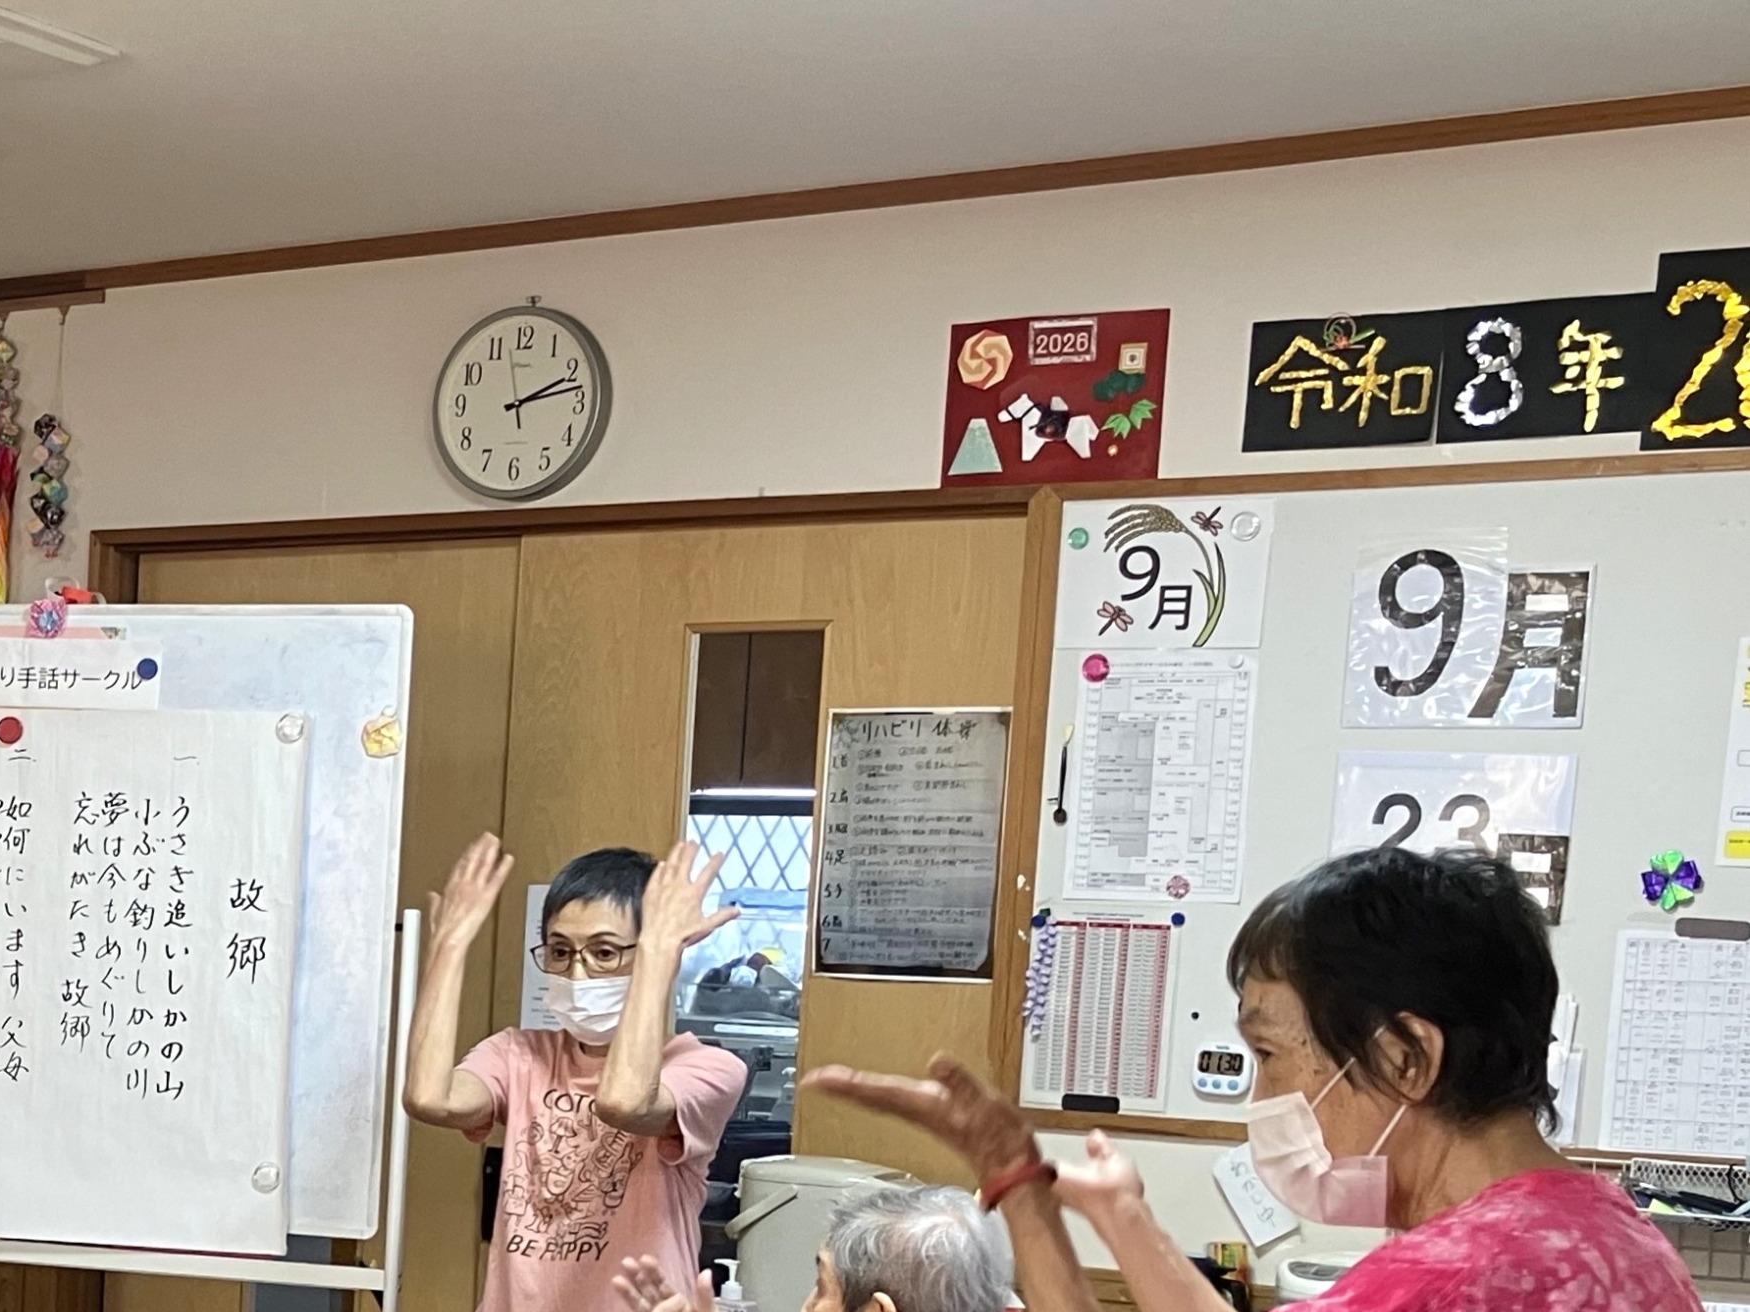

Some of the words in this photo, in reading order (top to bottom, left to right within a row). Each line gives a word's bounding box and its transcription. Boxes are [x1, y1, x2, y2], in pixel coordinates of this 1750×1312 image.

[488, 337, 503, 361] 11
[516, 325, 534, 351] 12
[550, 334, 558, 358] 1
[1036, 332, 1089, 355] 2026
[565, 358, 578, 383] 2
[1650, 278, 1750, 441] 2
[464, 361, 482, 386] 10
[455, 393, 467, 418] 9
[572, 389, 585, 415] 3
[460, 427, 472, 451] 8
[561, 422, 573, 447] 4
[481, 449, 493, 473] 7
[508, 457, 520, 481] 6
[538, 447, 551, 471] 5
[1118, 544, 1192, 632] 9月
[1373, 547, 1591, 719] 9月
[862, 718, 921, 743] リハビリ
[95, 792, 129, 1060] 夢は今もめぐりて
[226, 878, 268, 984] 故郷
[123, 798, 165, 1100] 小ぶな釣りしかの川
[155, 796, 194, 1100] うさぎ追いしかの山
[506, 1234, 539, 1259] BE
